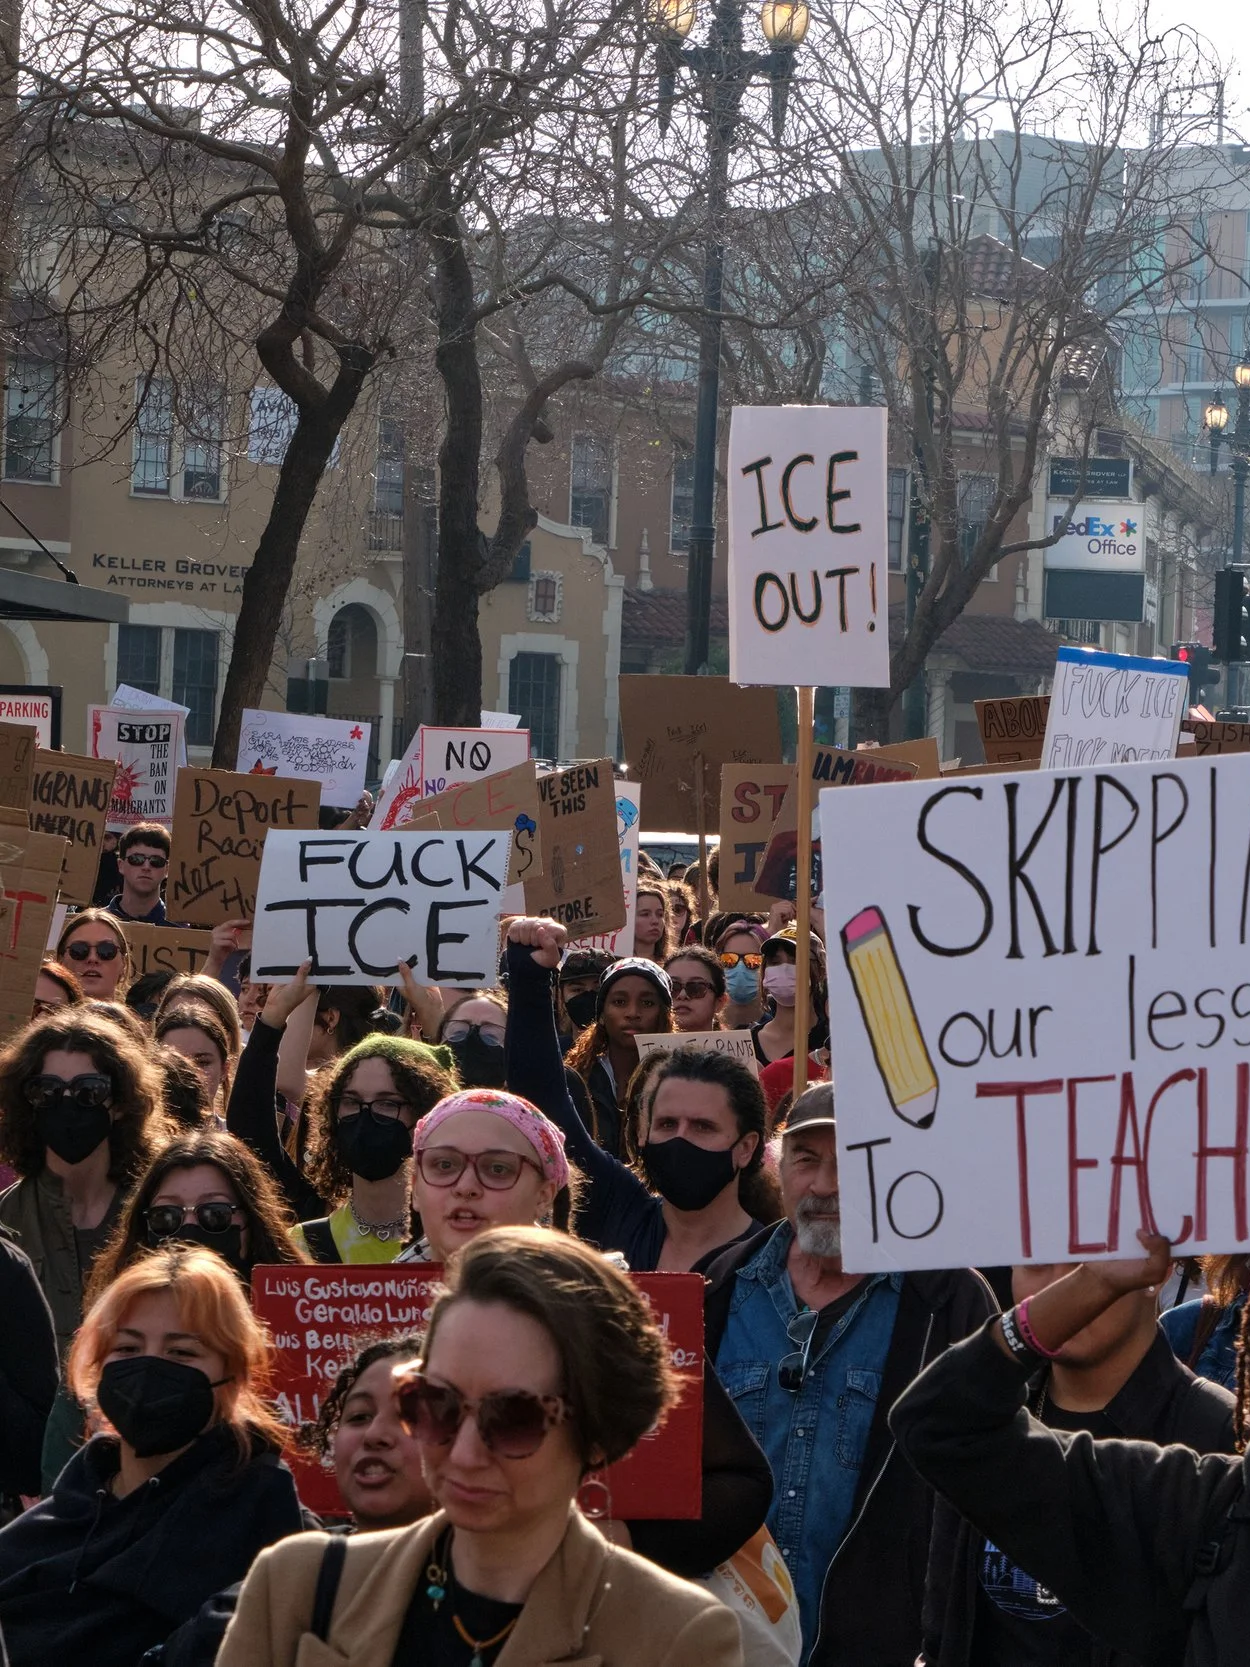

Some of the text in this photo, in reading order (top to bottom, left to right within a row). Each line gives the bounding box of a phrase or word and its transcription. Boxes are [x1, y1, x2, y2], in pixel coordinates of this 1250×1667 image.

[741, 450, 862, 538] ICE
[1053, 515, 1116, 537] FedEx
[1087, 538, 1137, 556] Office
[92, 553, 166, 573] KELLER
[107, 574, 244, 594] ATTORNEYS AT LA
[753, 561, 877, 634] OUT!
[1062, 661, 1180, 719] FUCK ICE
[0, 701, 49, 719] PARKING
[118, 723, 171, 742] STOP
[150, 743, 169, 759] THE
[1049, 734, 1108, 771] FUCK
[149, 762, 168, 778] BAN
[560, 765, 599, 798] SEEN
[154, 780, 167, 795] ON
[424, 777, 447, 798] NO
[110, 797, 166, 815] MMIGRANTS
[189, 778, 308, 835] Deport
[549, 793, 586, 818] THIS
[299, 838, 502, 892] FUCK
[256, 896, 490, 982] ICE
[938, 1004, 1054, 1067] our
[975, 1062, 1250, 1258] TEACH
[264, 1276, 301, 1298] Luis
[303, 1277, 384, 1301] Gustavo
[295, 1298, 383, 1325] Geraldo
